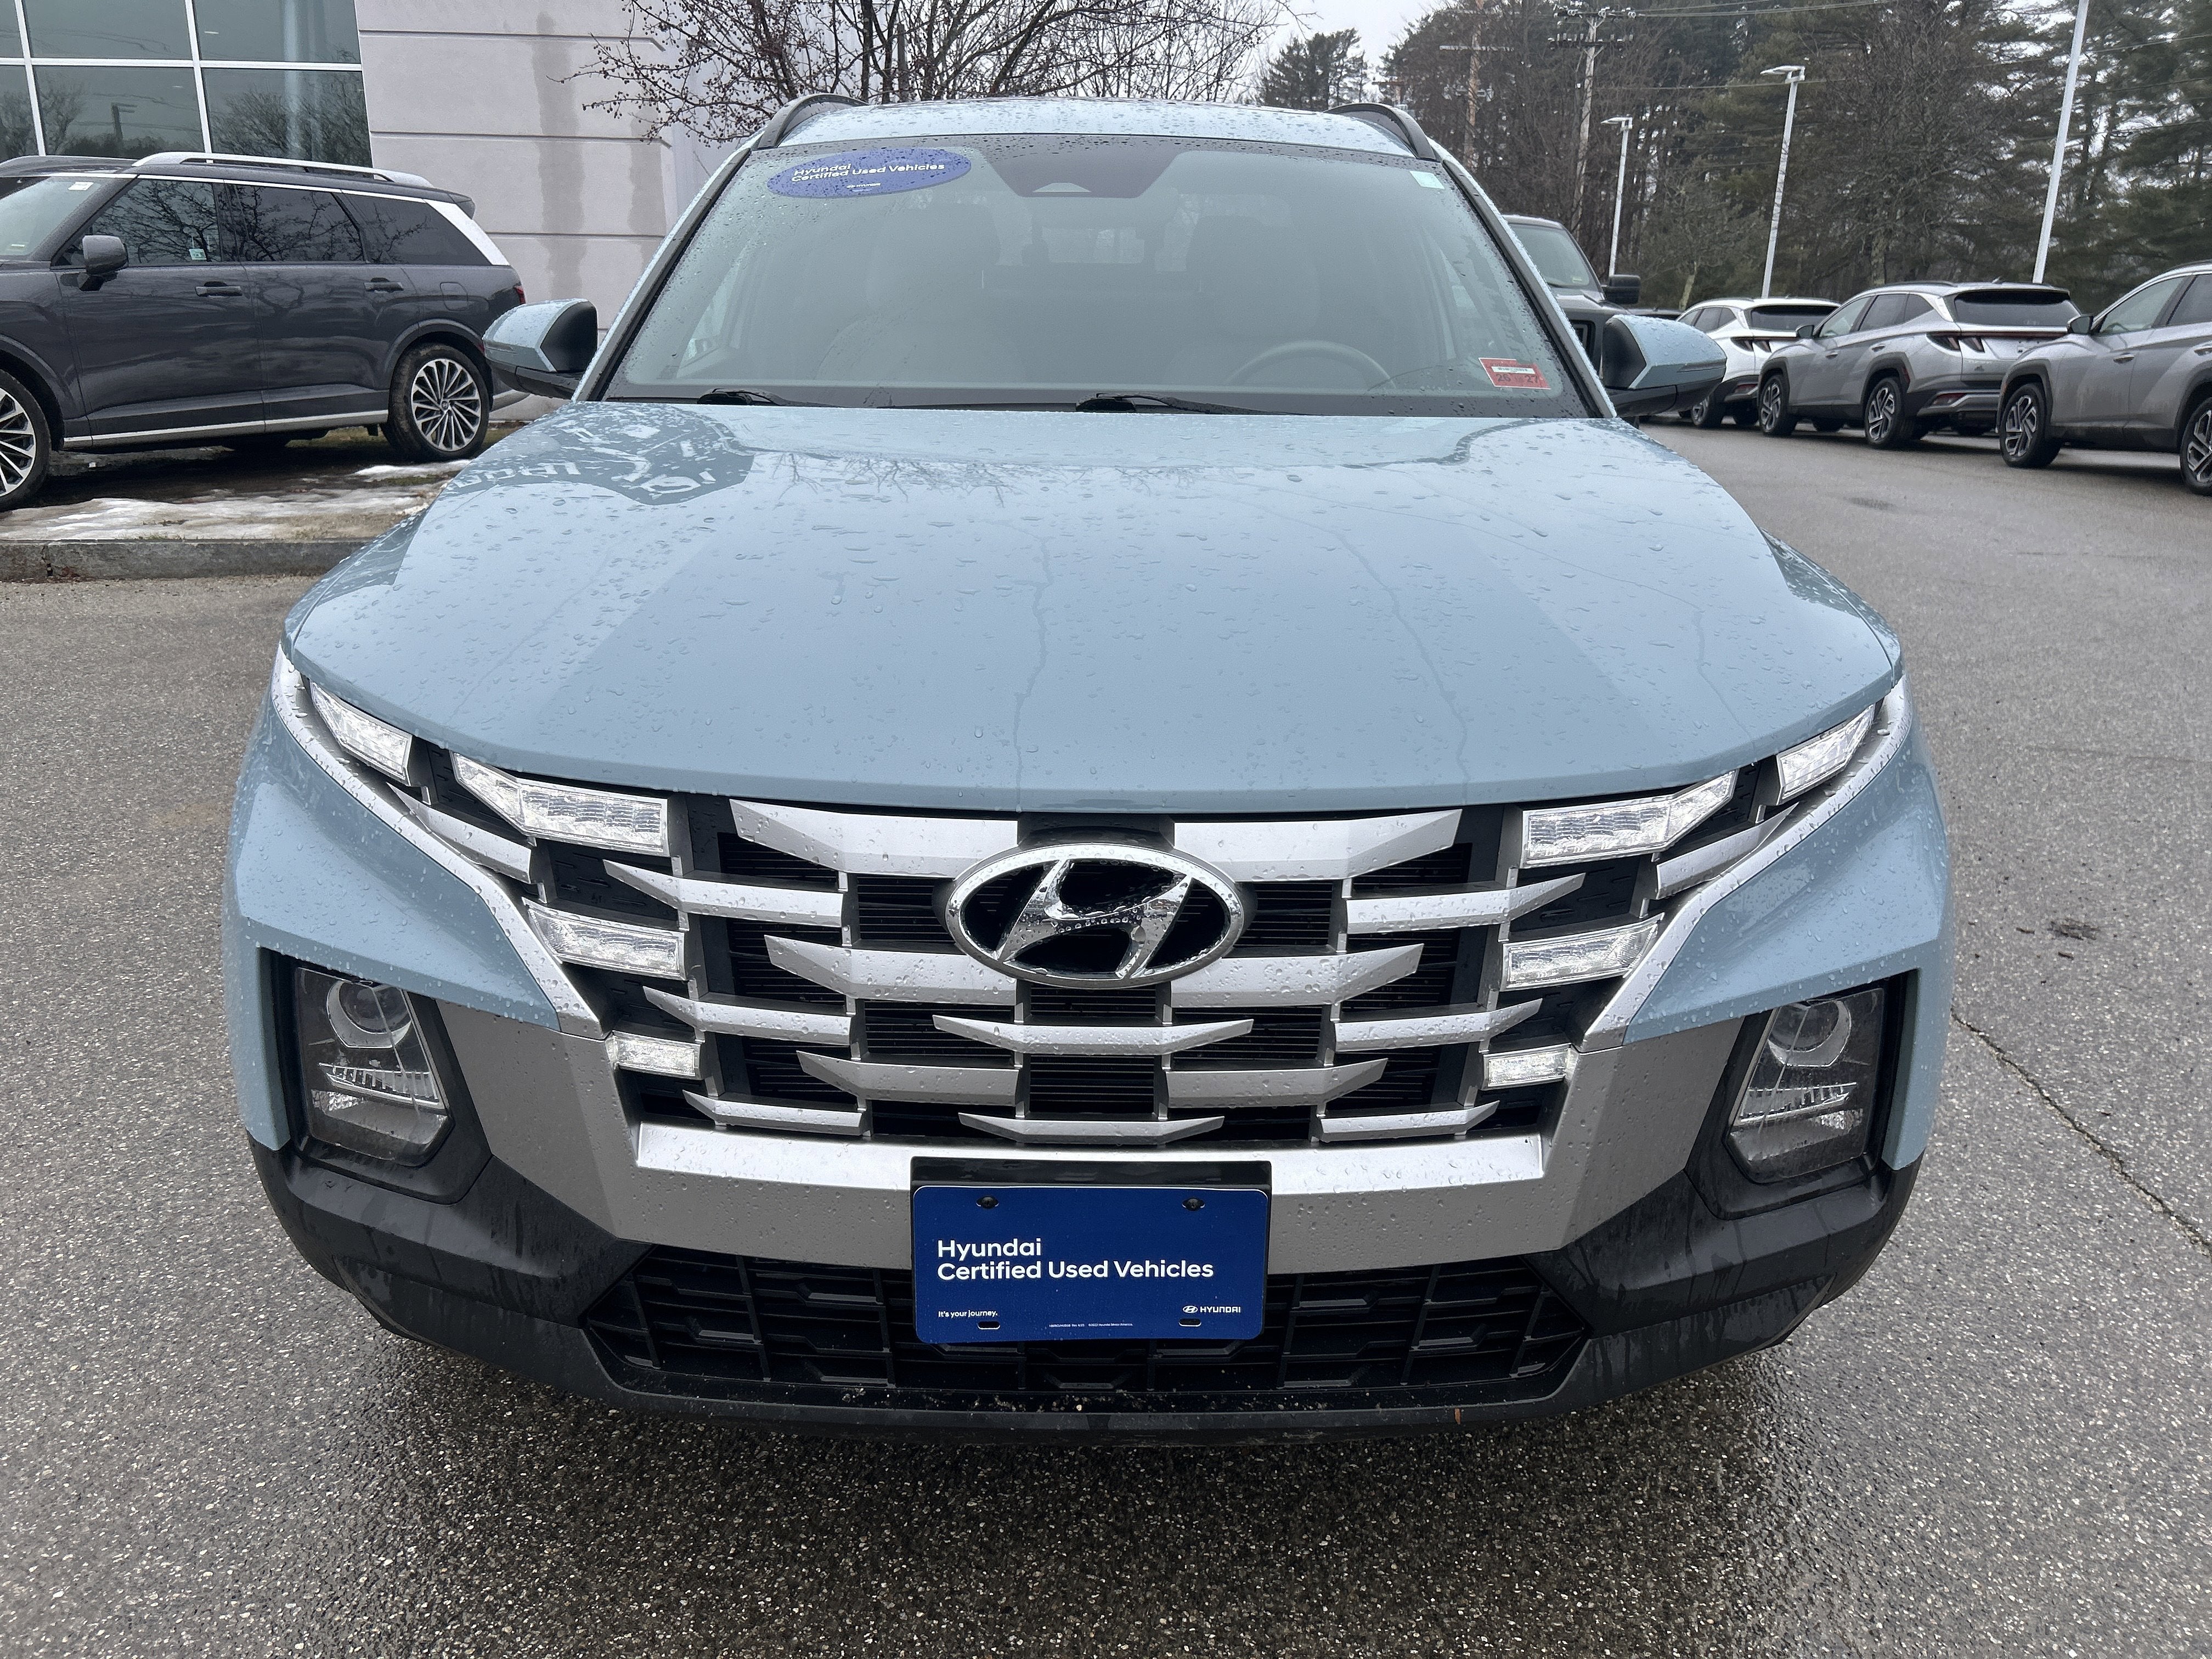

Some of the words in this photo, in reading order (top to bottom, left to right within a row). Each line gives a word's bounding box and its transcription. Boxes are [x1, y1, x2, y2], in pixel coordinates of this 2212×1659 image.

[791, 170, 849, 182] Certified
[852, 166, 886, 175] Used
[889, 164, 945, 172] Vehicles
[794, 163, 851, 176] Hyundai
[938, 1238, 1041, 1261] Hyundai
[937, 1260, 1041, 1280] Certified
[1048, 1260, 1108, 1278] Used
[1113, 1259, 1214, 1277] Vehicles
[968, 1310, 998, 1318] journey.
